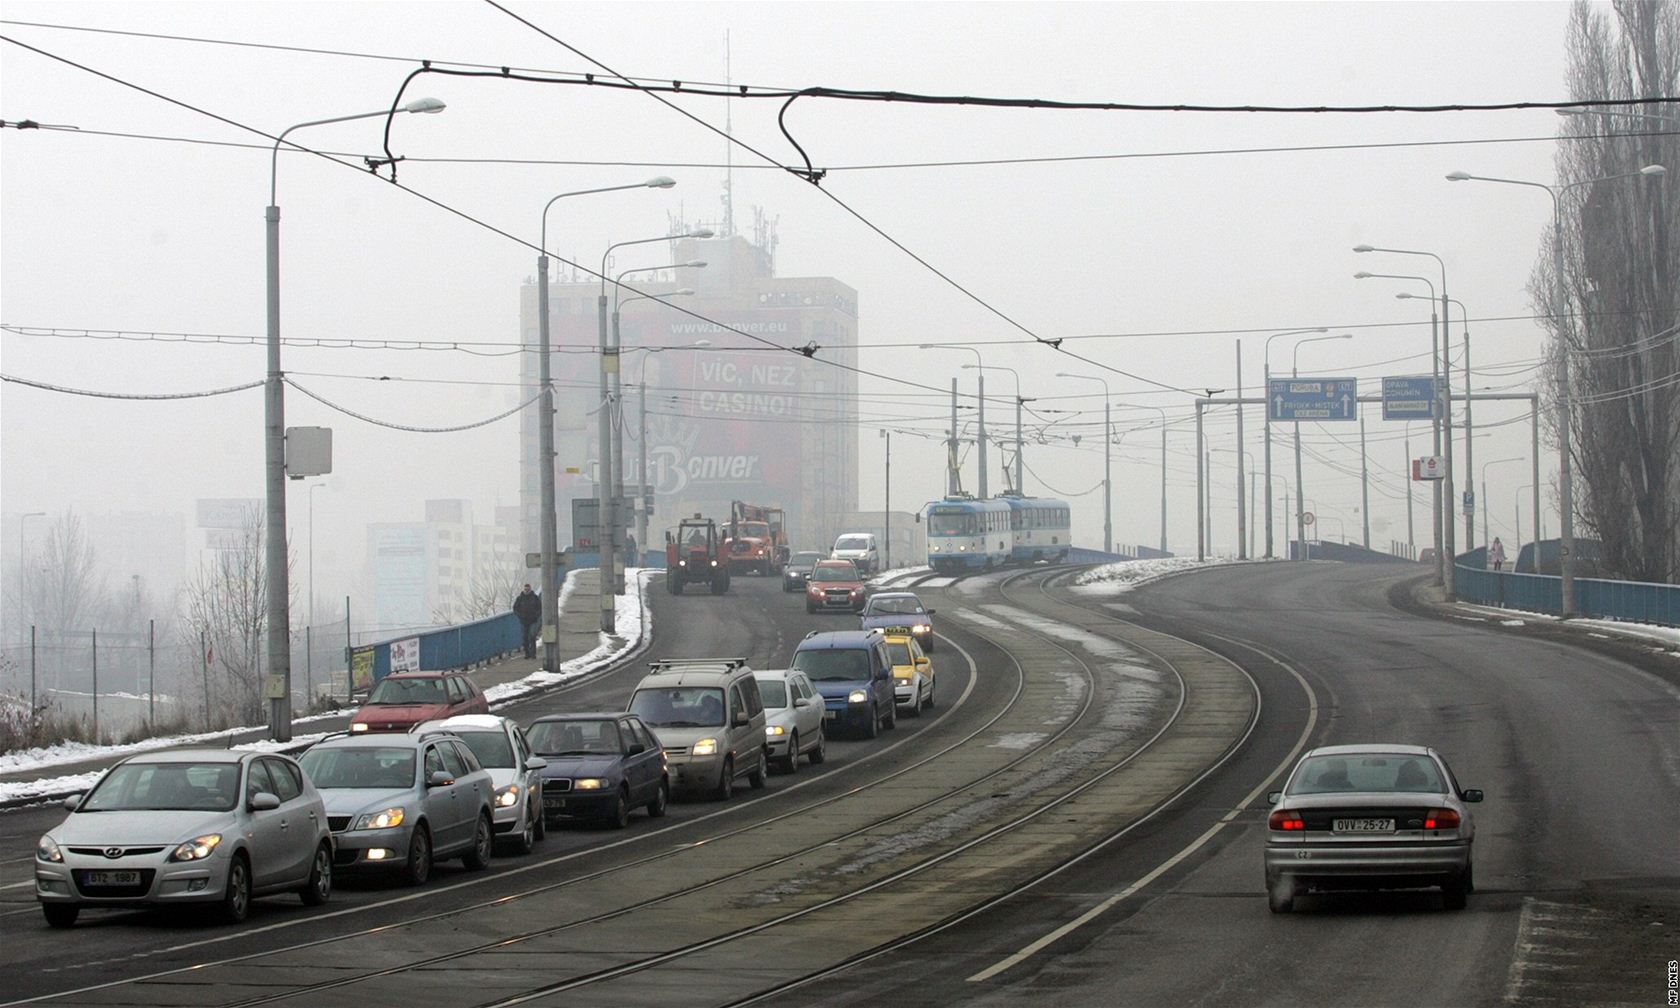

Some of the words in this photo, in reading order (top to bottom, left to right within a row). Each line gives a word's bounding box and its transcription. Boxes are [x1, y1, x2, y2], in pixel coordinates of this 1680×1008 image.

[671, 320, 788, 334] www.bonver.eu
[751, 361, 797, 386] NEŽ
[699, 391, 793, 416] CASINO!
[1337, 820, 1356, 831] OVV
[1298, 850, 1308, 859] CZ
